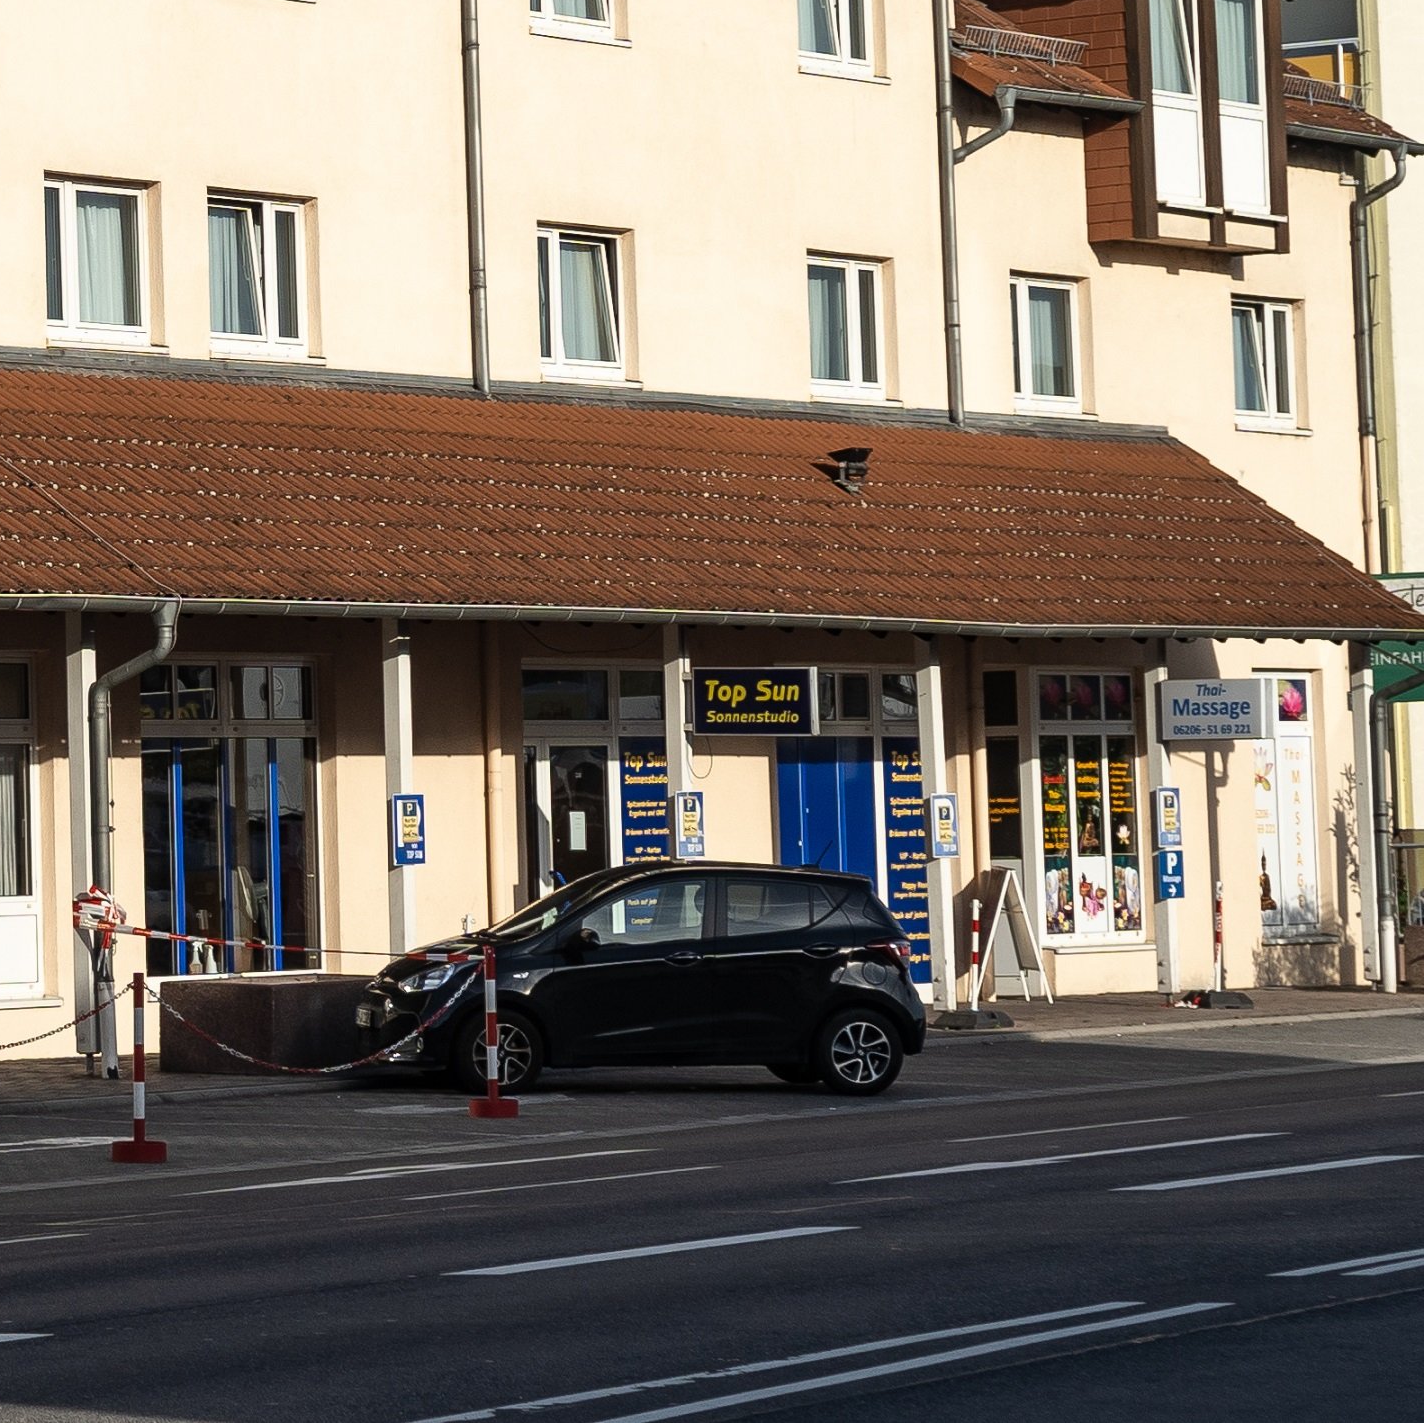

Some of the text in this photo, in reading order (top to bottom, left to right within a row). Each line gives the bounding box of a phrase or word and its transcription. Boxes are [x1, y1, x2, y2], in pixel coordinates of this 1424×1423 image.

[705, 680, 800, 708] Top Sun
[1196, 683, 1227, 696] Thai-
[706, 710, 800, 723] Sonnenstudio
[1173, 698, 1251, 719] Massage
[1234, 724, 1252, 734] 221
[624, 751, 643, 772] Top
[1167, 852, 1178, 875] P
